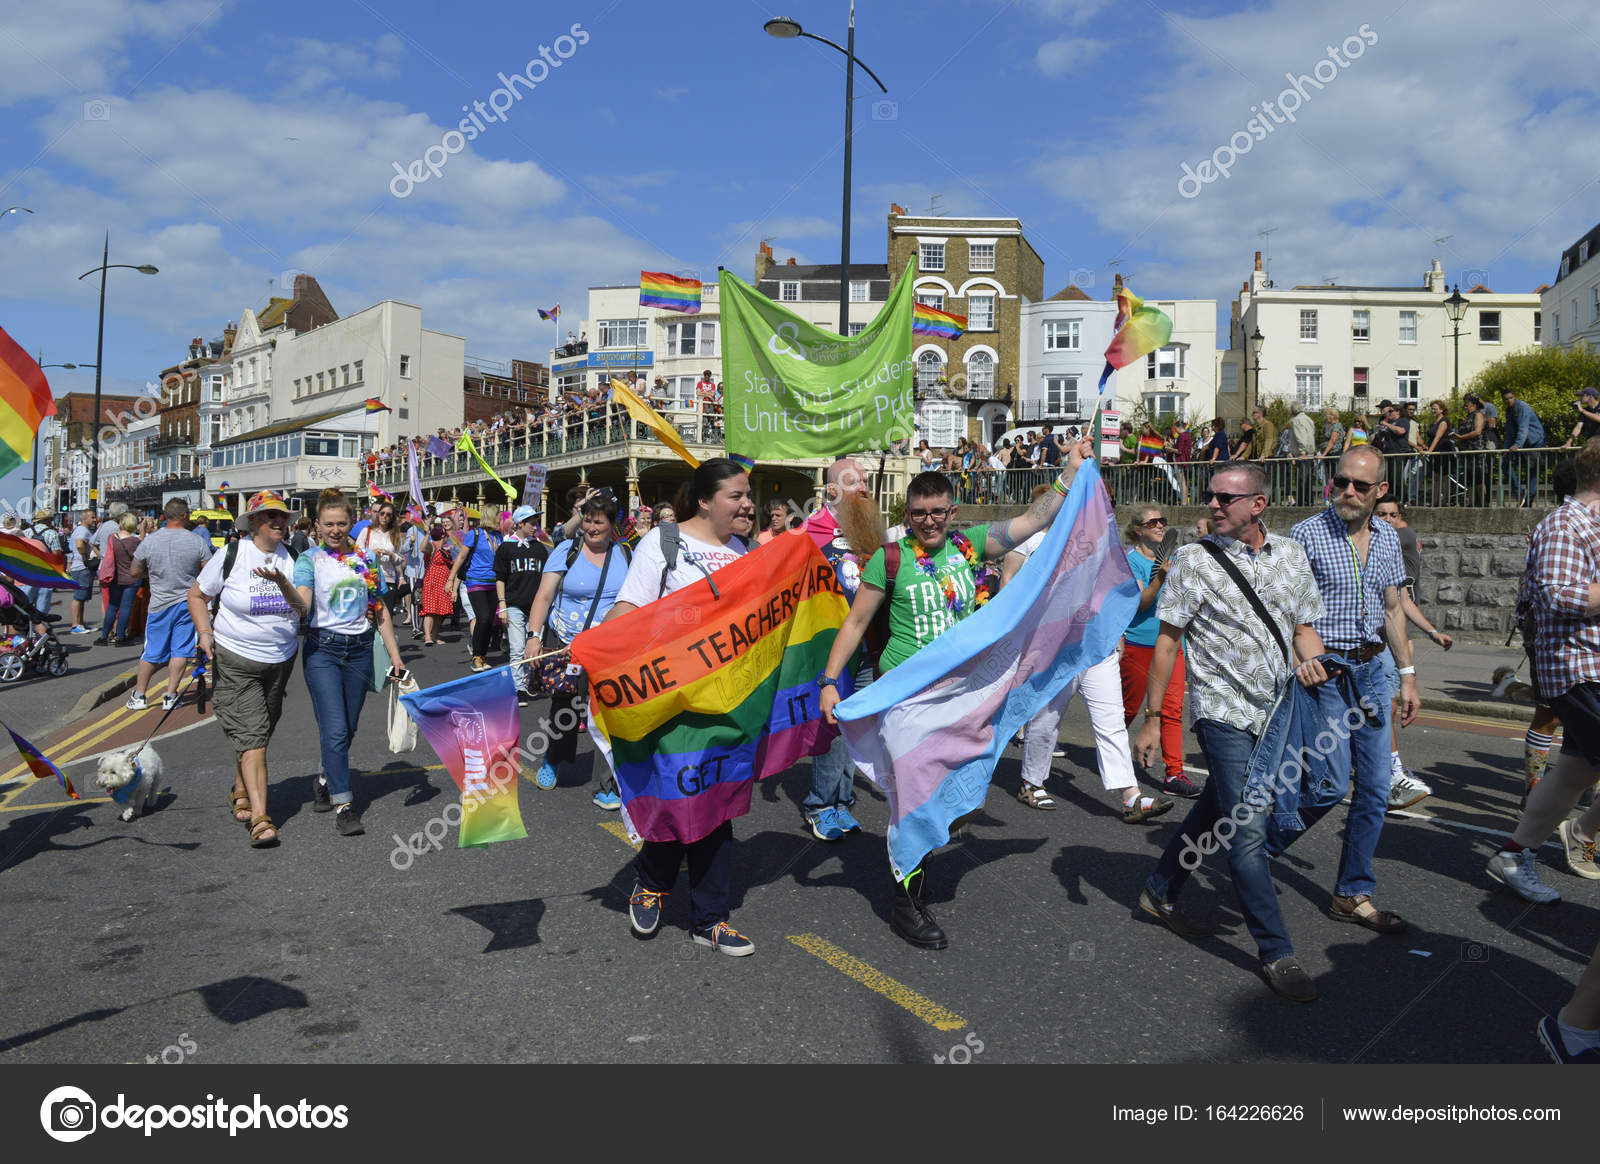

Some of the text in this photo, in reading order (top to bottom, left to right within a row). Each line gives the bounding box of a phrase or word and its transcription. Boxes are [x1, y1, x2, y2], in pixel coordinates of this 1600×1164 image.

[744, 403, 829, 432] United
[840, 406, 865, 431] in
[793, 387, 833, 407] and
[905, 567, 976, 615] TRNS
[594, 656, 678, 708] OME
[676, 692, 811, 797] GET IT
